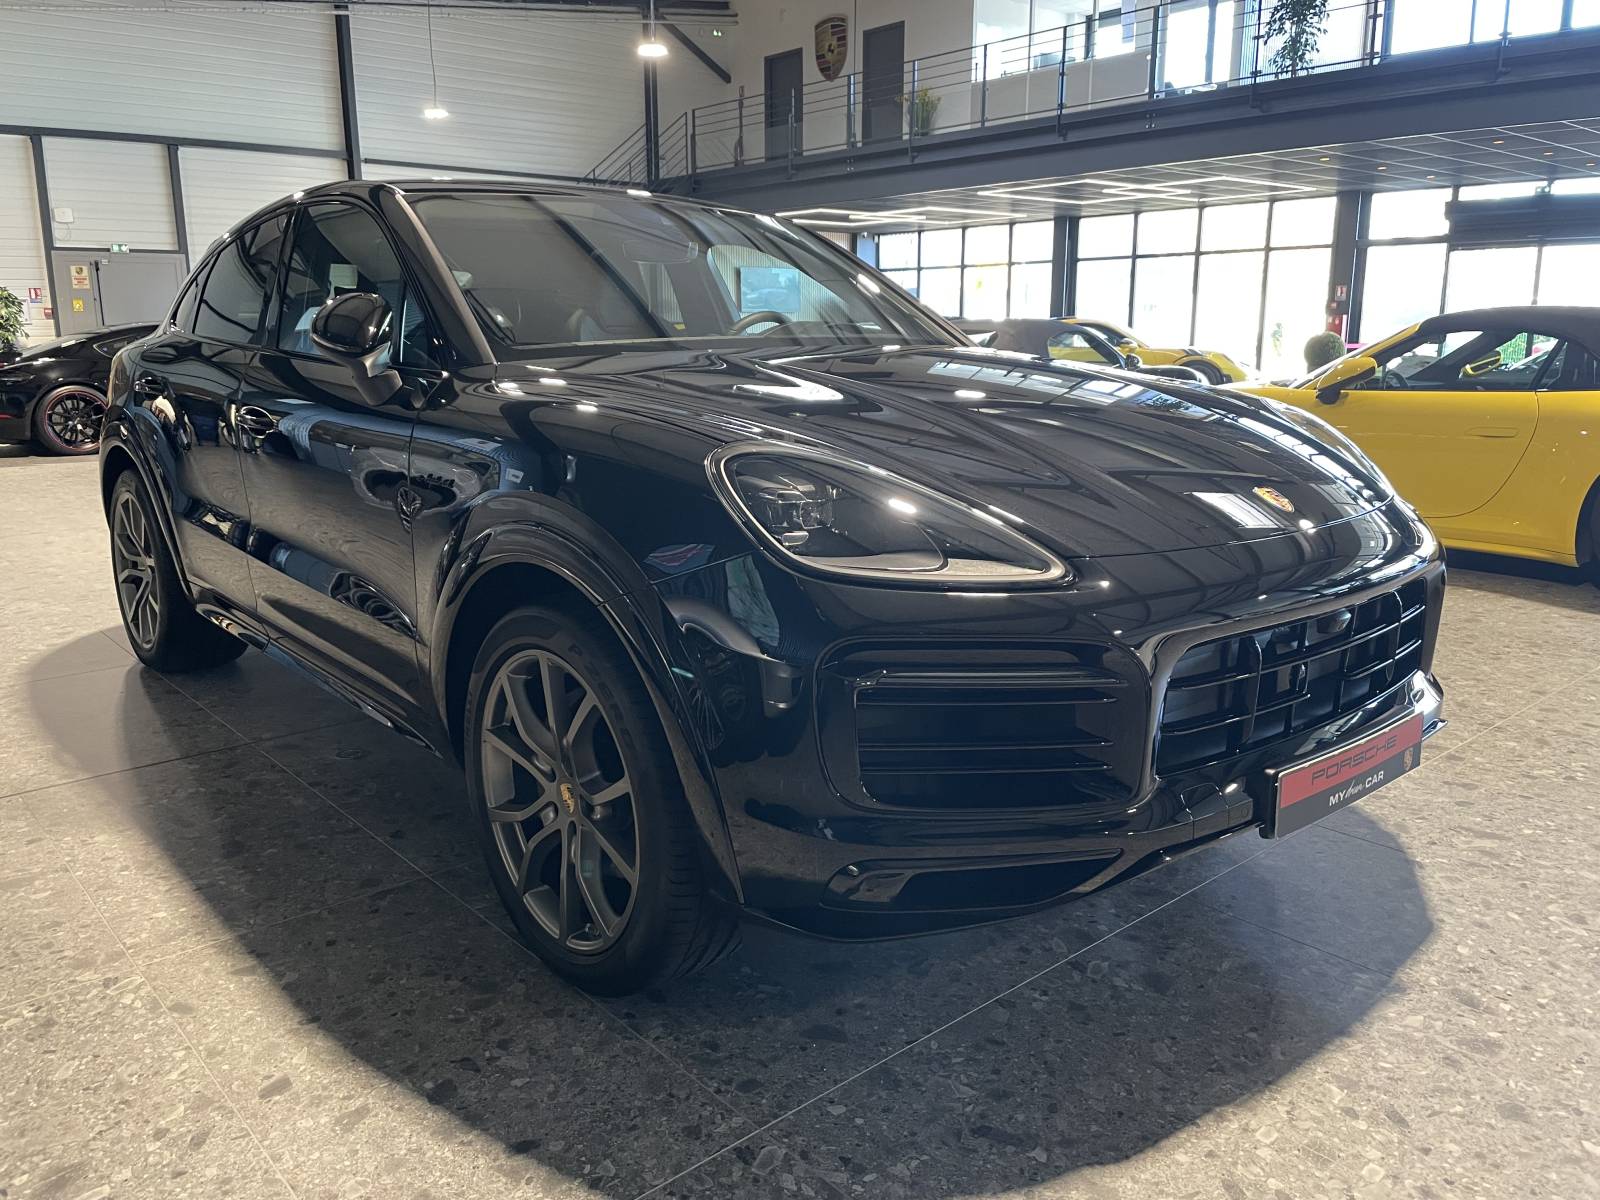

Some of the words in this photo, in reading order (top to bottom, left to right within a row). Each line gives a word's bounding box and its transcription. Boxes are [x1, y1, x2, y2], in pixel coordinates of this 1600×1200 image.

[1312, 735, 1396, 785] PORSCHE
[1329, 789, 1346, 806] MY
[1365, 771, 1384, 788] CAR
